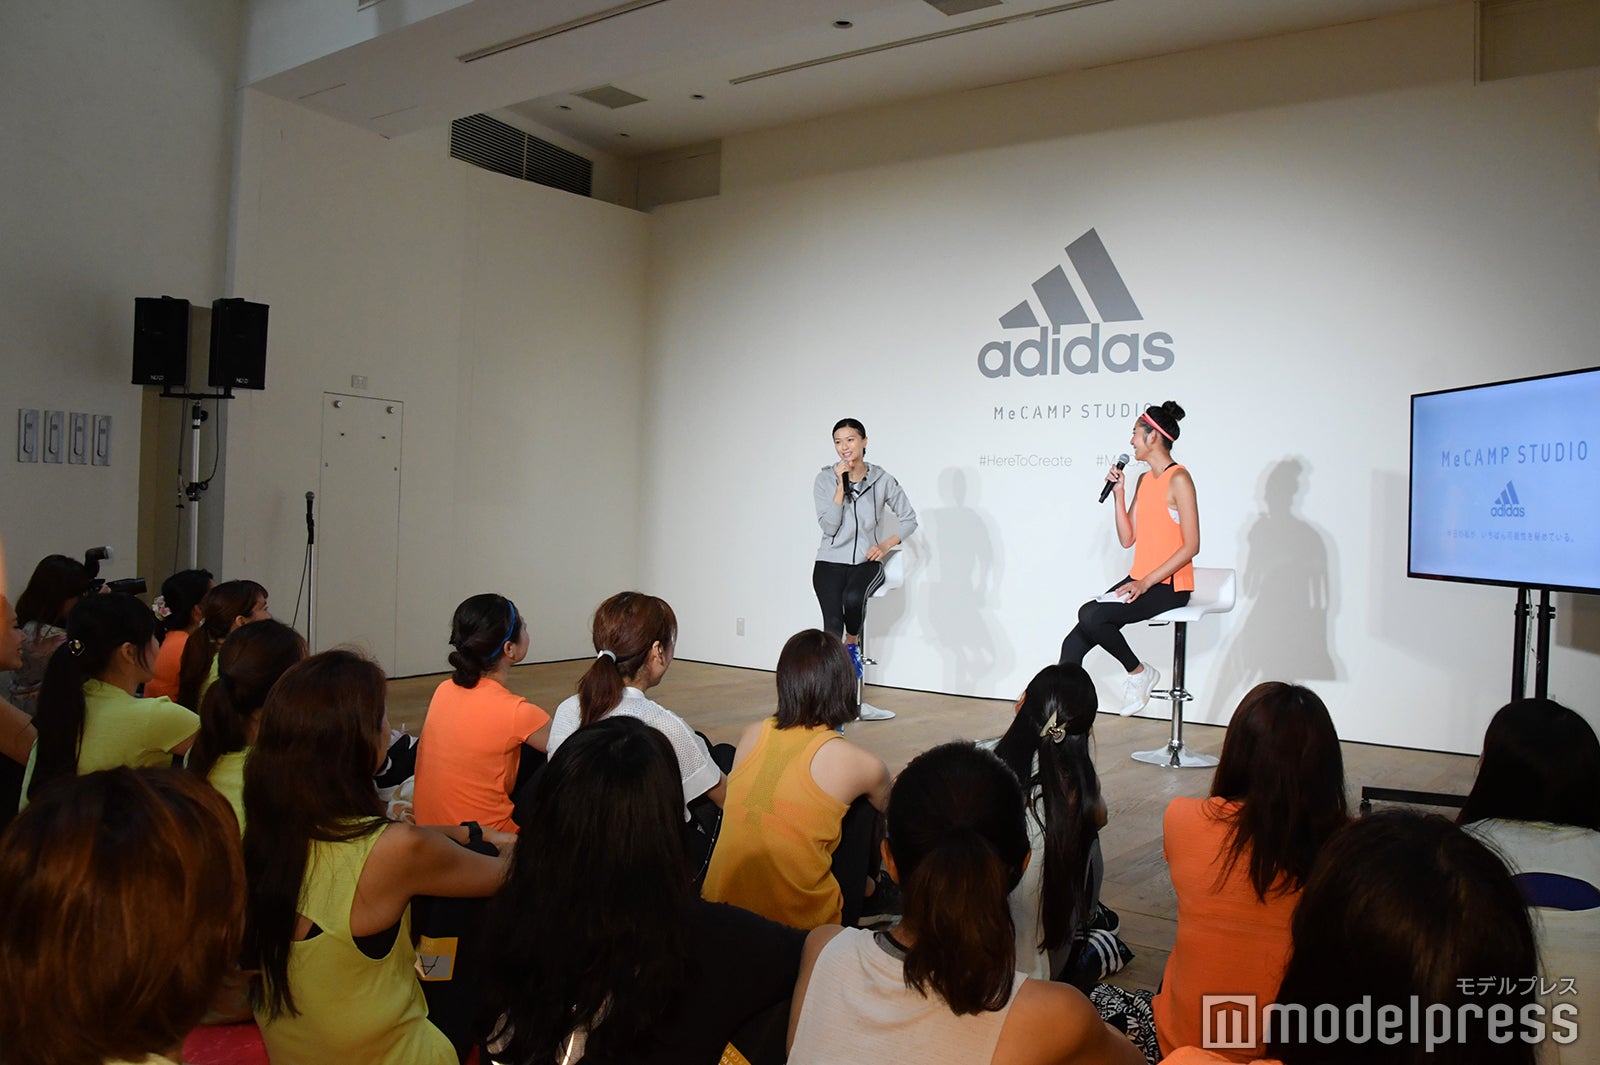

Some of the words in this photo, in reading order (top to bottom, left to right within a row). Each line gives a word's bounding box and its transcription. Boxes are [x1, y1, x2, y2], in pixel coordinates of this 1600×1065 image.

[977, 322, 1175, 379] adidas
[993, 405, 1072, 420] MeCAMP
[979, 453, 1072, 467] #HereToCreate
[1441, 446, 1510, 468] MeCAMP
[1517, 440, 1589, 464] STUDIO
[1490, 503, 1526, 518] adidas
